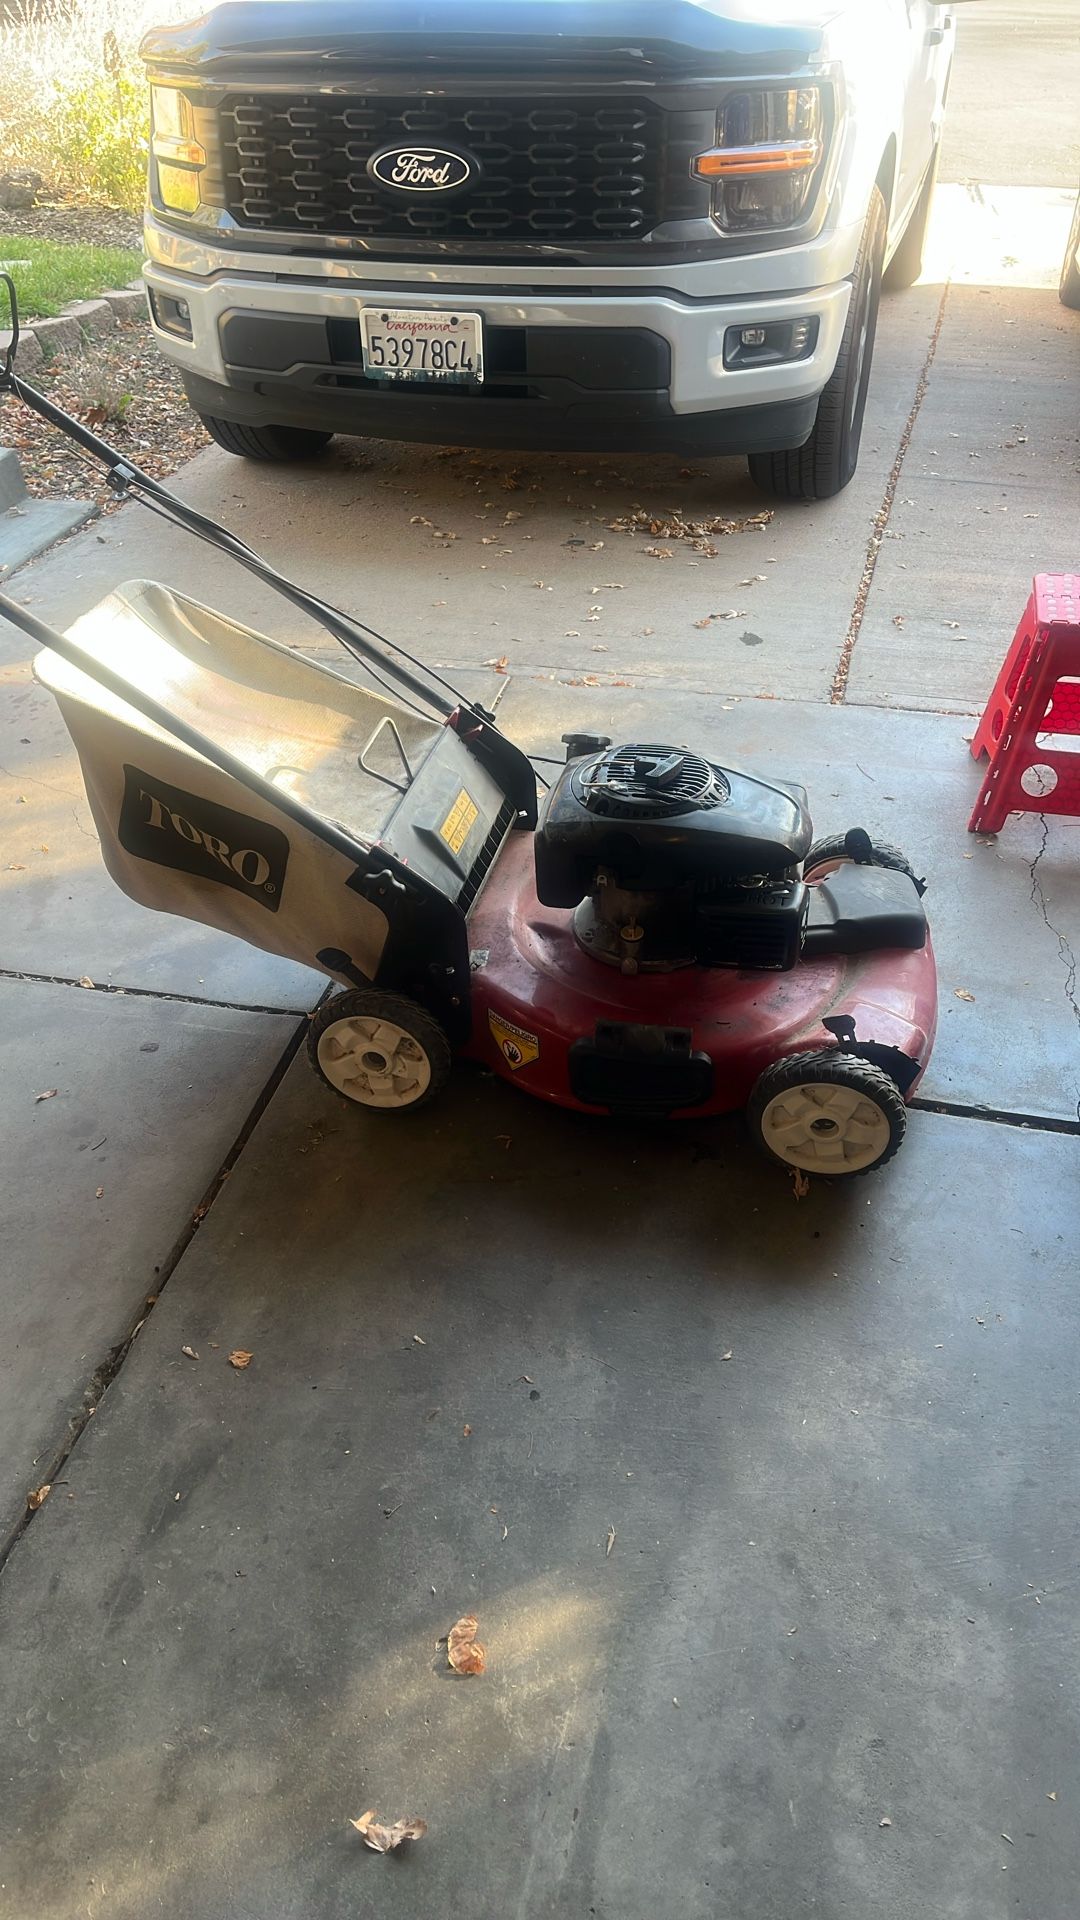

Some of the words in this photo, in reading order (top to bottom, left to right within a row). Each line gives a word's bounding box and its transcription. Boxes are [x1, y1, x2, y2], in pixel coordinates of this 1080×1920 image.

[392, 153, 450, 184] Ford
[386, 321, 458, 336] California
[371, 335, 473, 371] 53978C4
[139, 789, 271, 887] TORO
